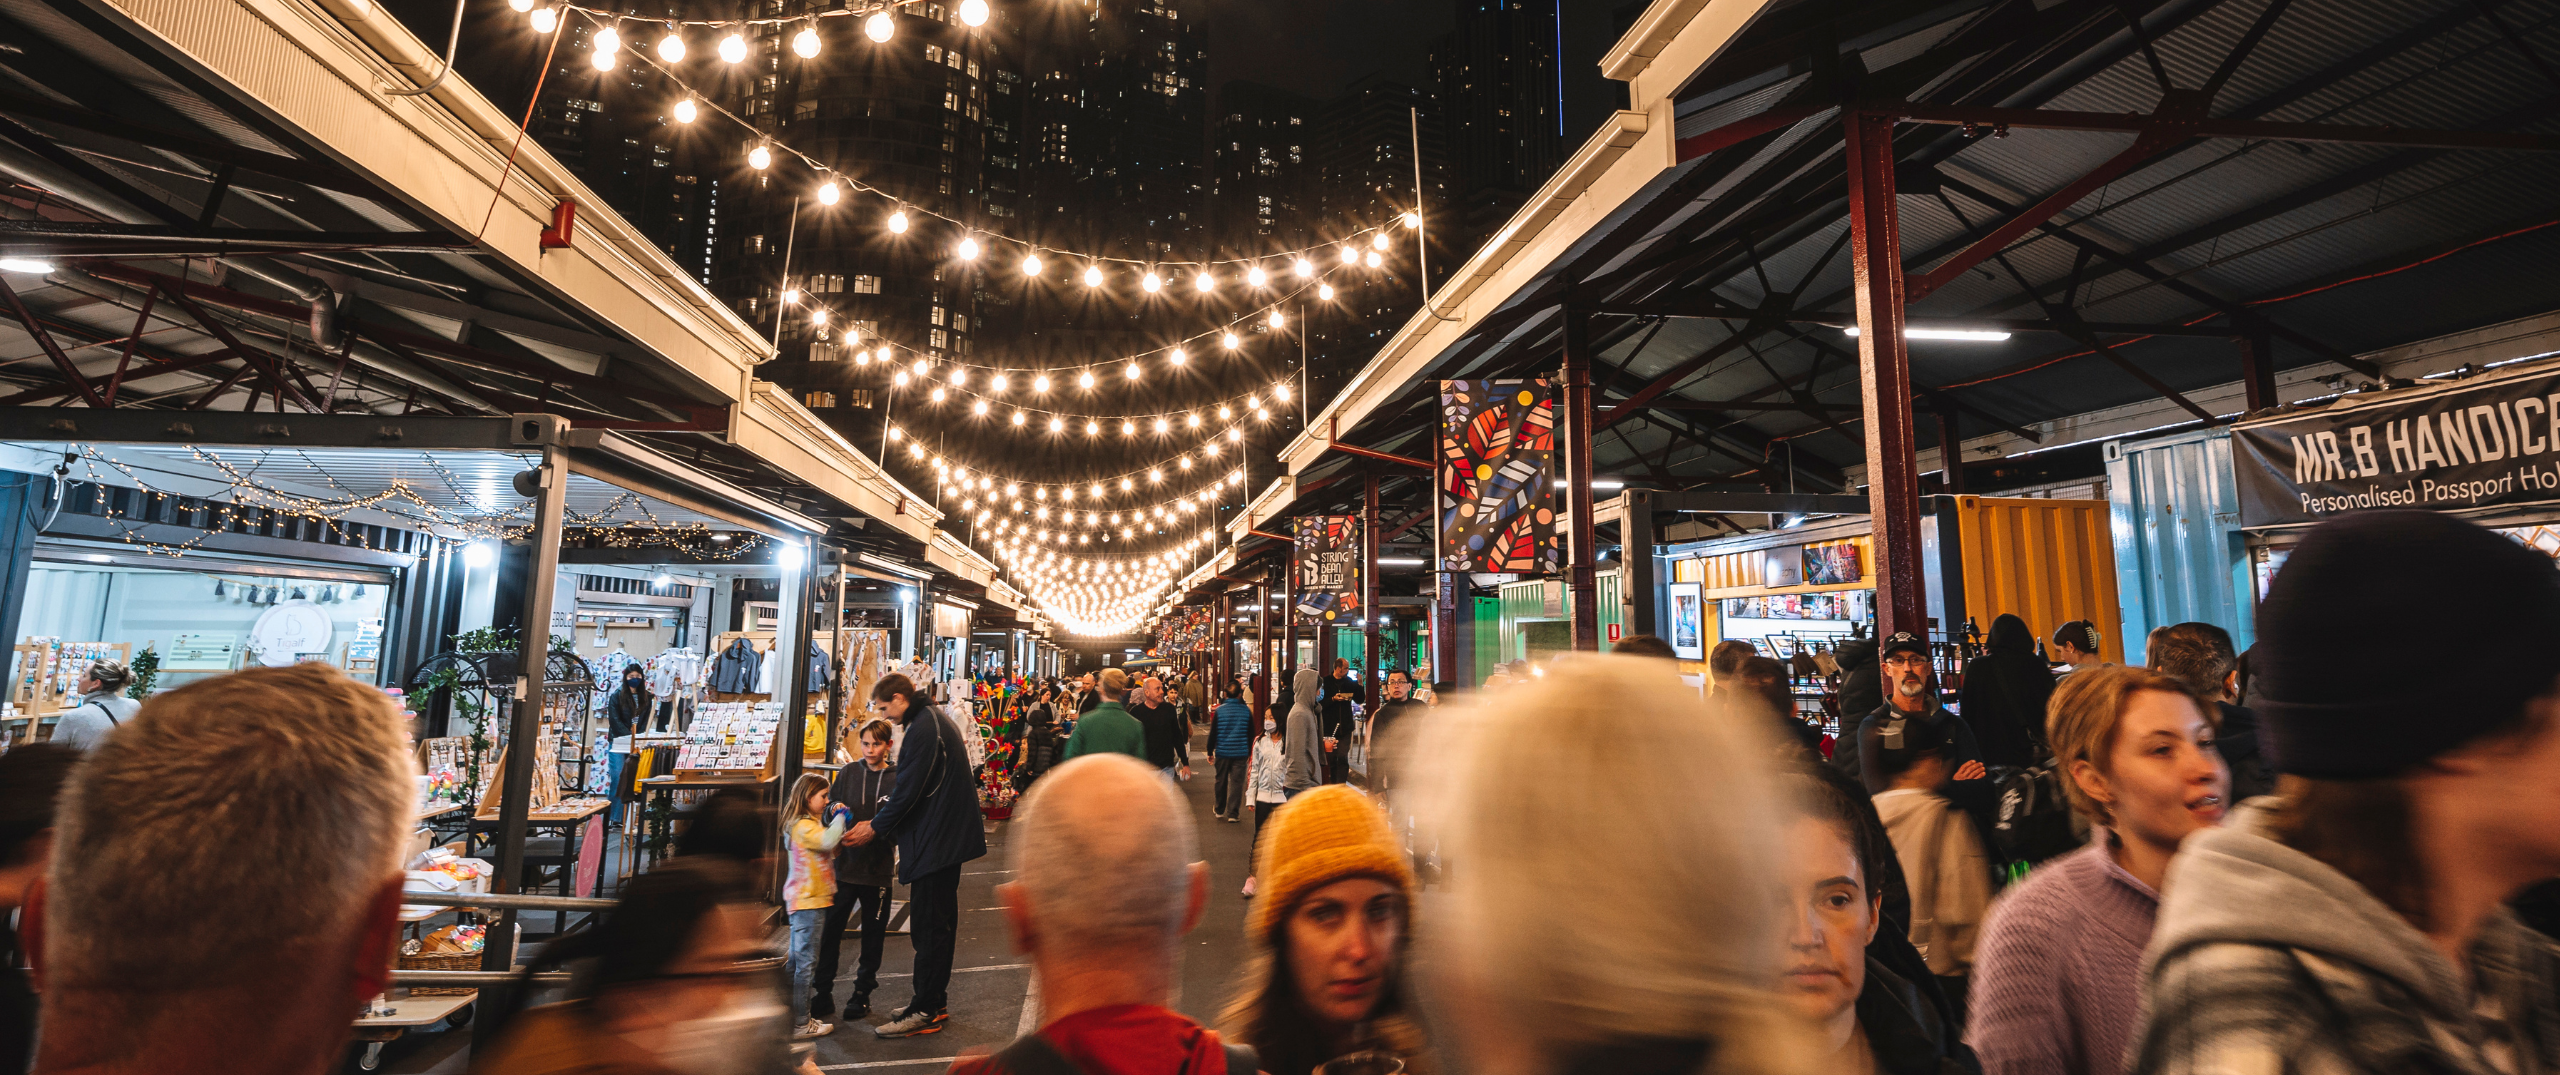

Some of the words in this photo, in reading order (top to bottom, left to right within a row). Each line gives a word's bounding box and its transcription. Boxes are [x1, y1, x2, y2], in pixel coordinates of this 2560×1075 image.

[2290, 426, 2380, 484] MR.B
[2300, 479, 2416, 513] Personalised
[2422, 471, 2513, 504] Passport
[1322, 552, 1348, 562] STRING
[1321, 563, 1341, 573] BEAN
[1321, 574, 1344, 584] ALLEY
